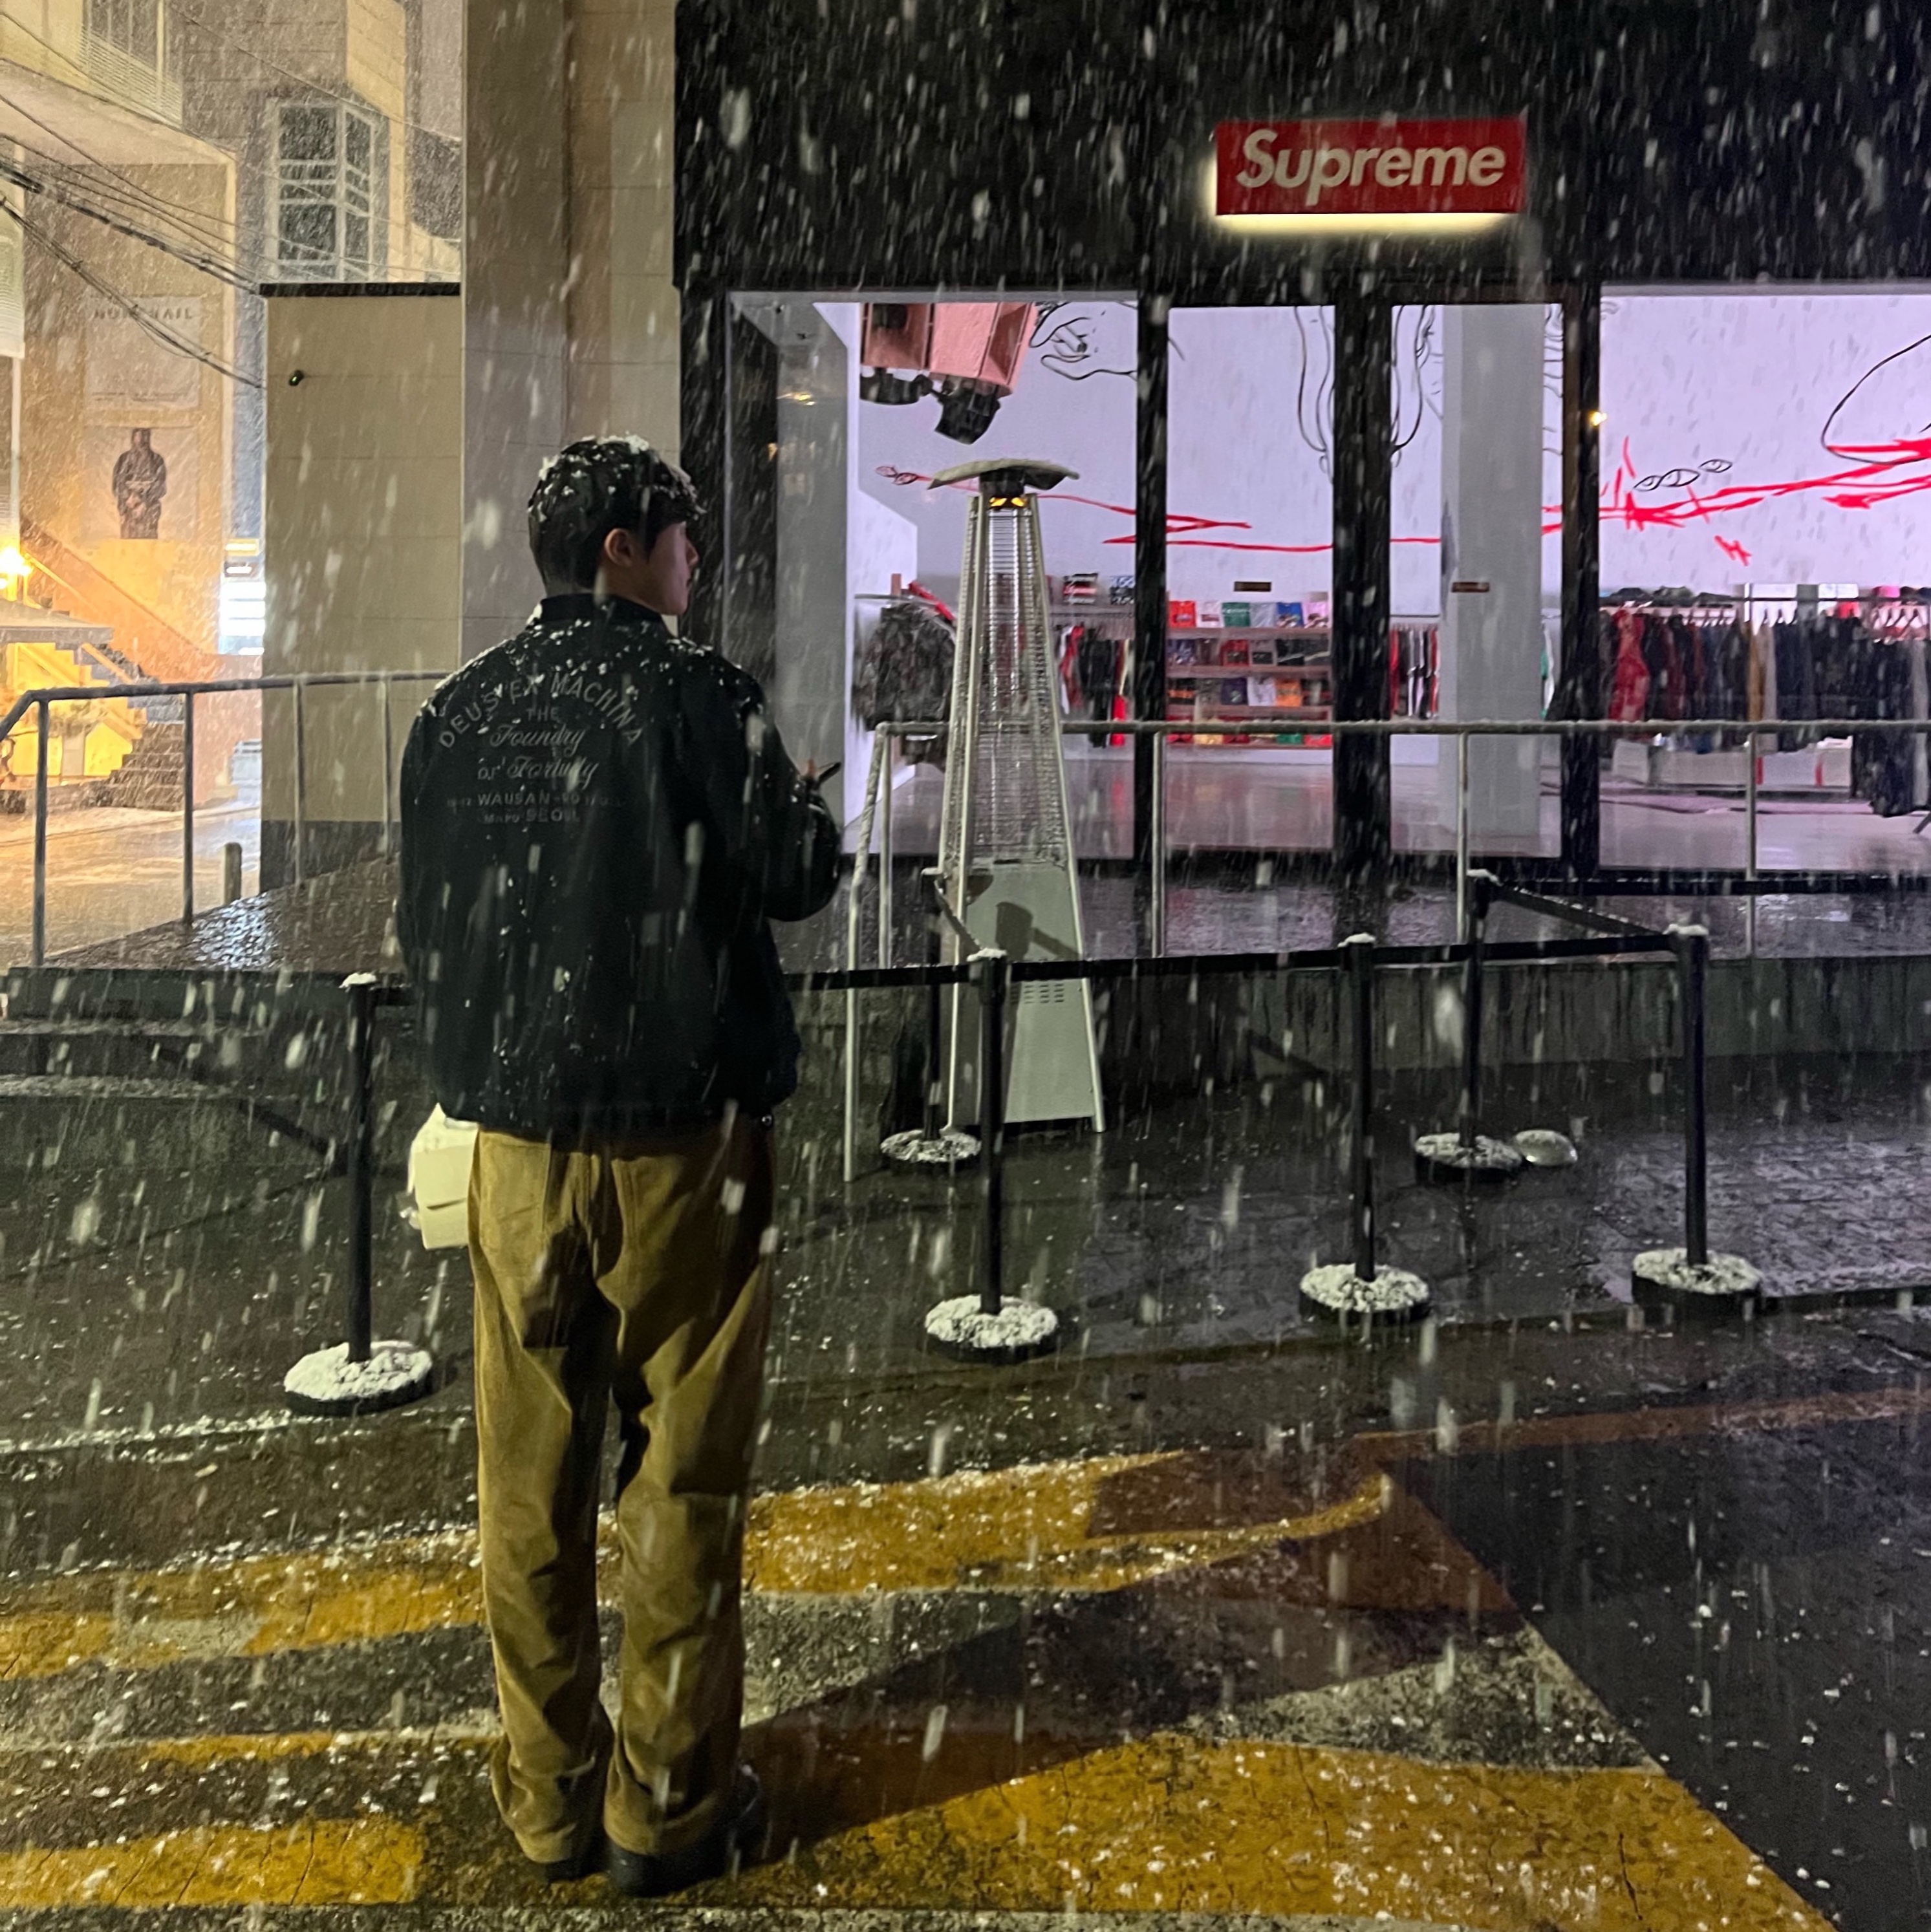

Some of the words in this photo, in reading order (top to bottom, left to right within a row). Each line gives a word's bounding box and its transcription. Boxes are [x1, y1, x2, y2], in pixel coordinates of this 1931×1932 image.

[1236, 129, 1505, 206] Supreme
[439, 691, 501, 748] DEUS
[550, 672, 642, 746] MACHINA
[525, 707, 560, 723] THE
[490, 724, 586, 758] Foundry
[507, 755, 599, 790] Fortuty
